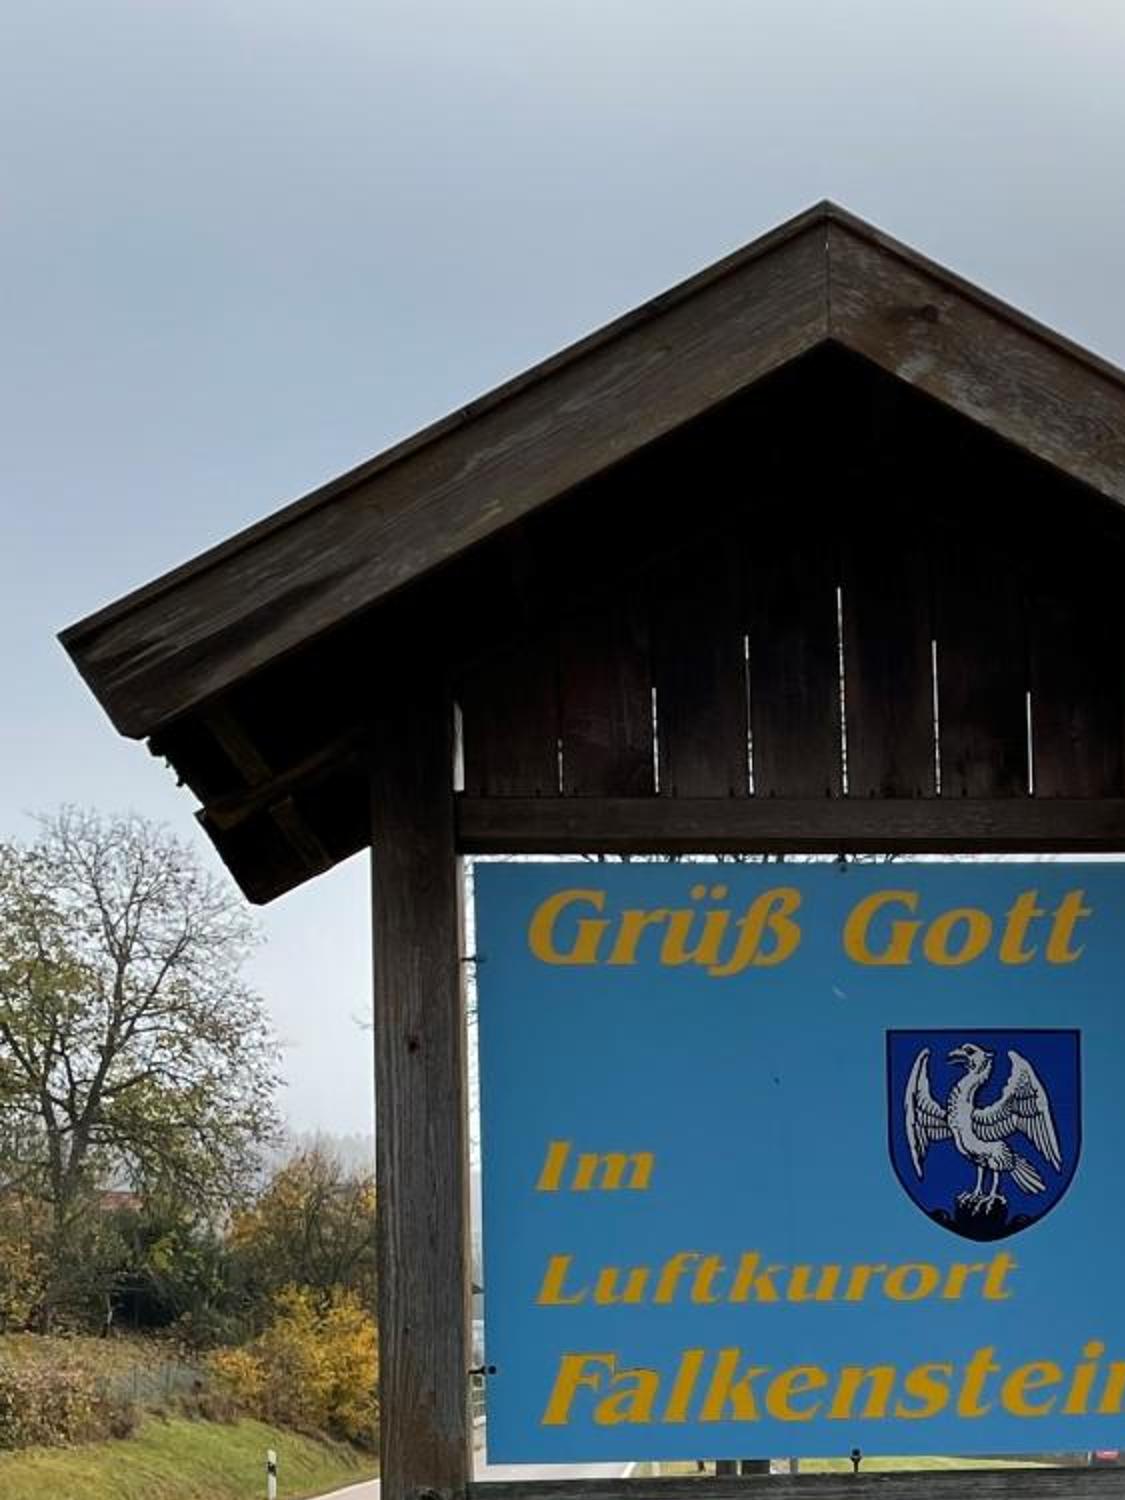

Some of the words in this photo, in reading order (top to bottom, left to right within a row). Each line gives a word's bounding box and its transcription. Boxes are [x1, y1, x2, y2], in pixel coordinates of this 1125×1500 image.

[529, 885, 800, 976] Grüß
[843, 890, 1088, 966] Gott
[537, 1141, 654, 1191] Im
[537, 1251, 1015, 1305] Luftkurort
